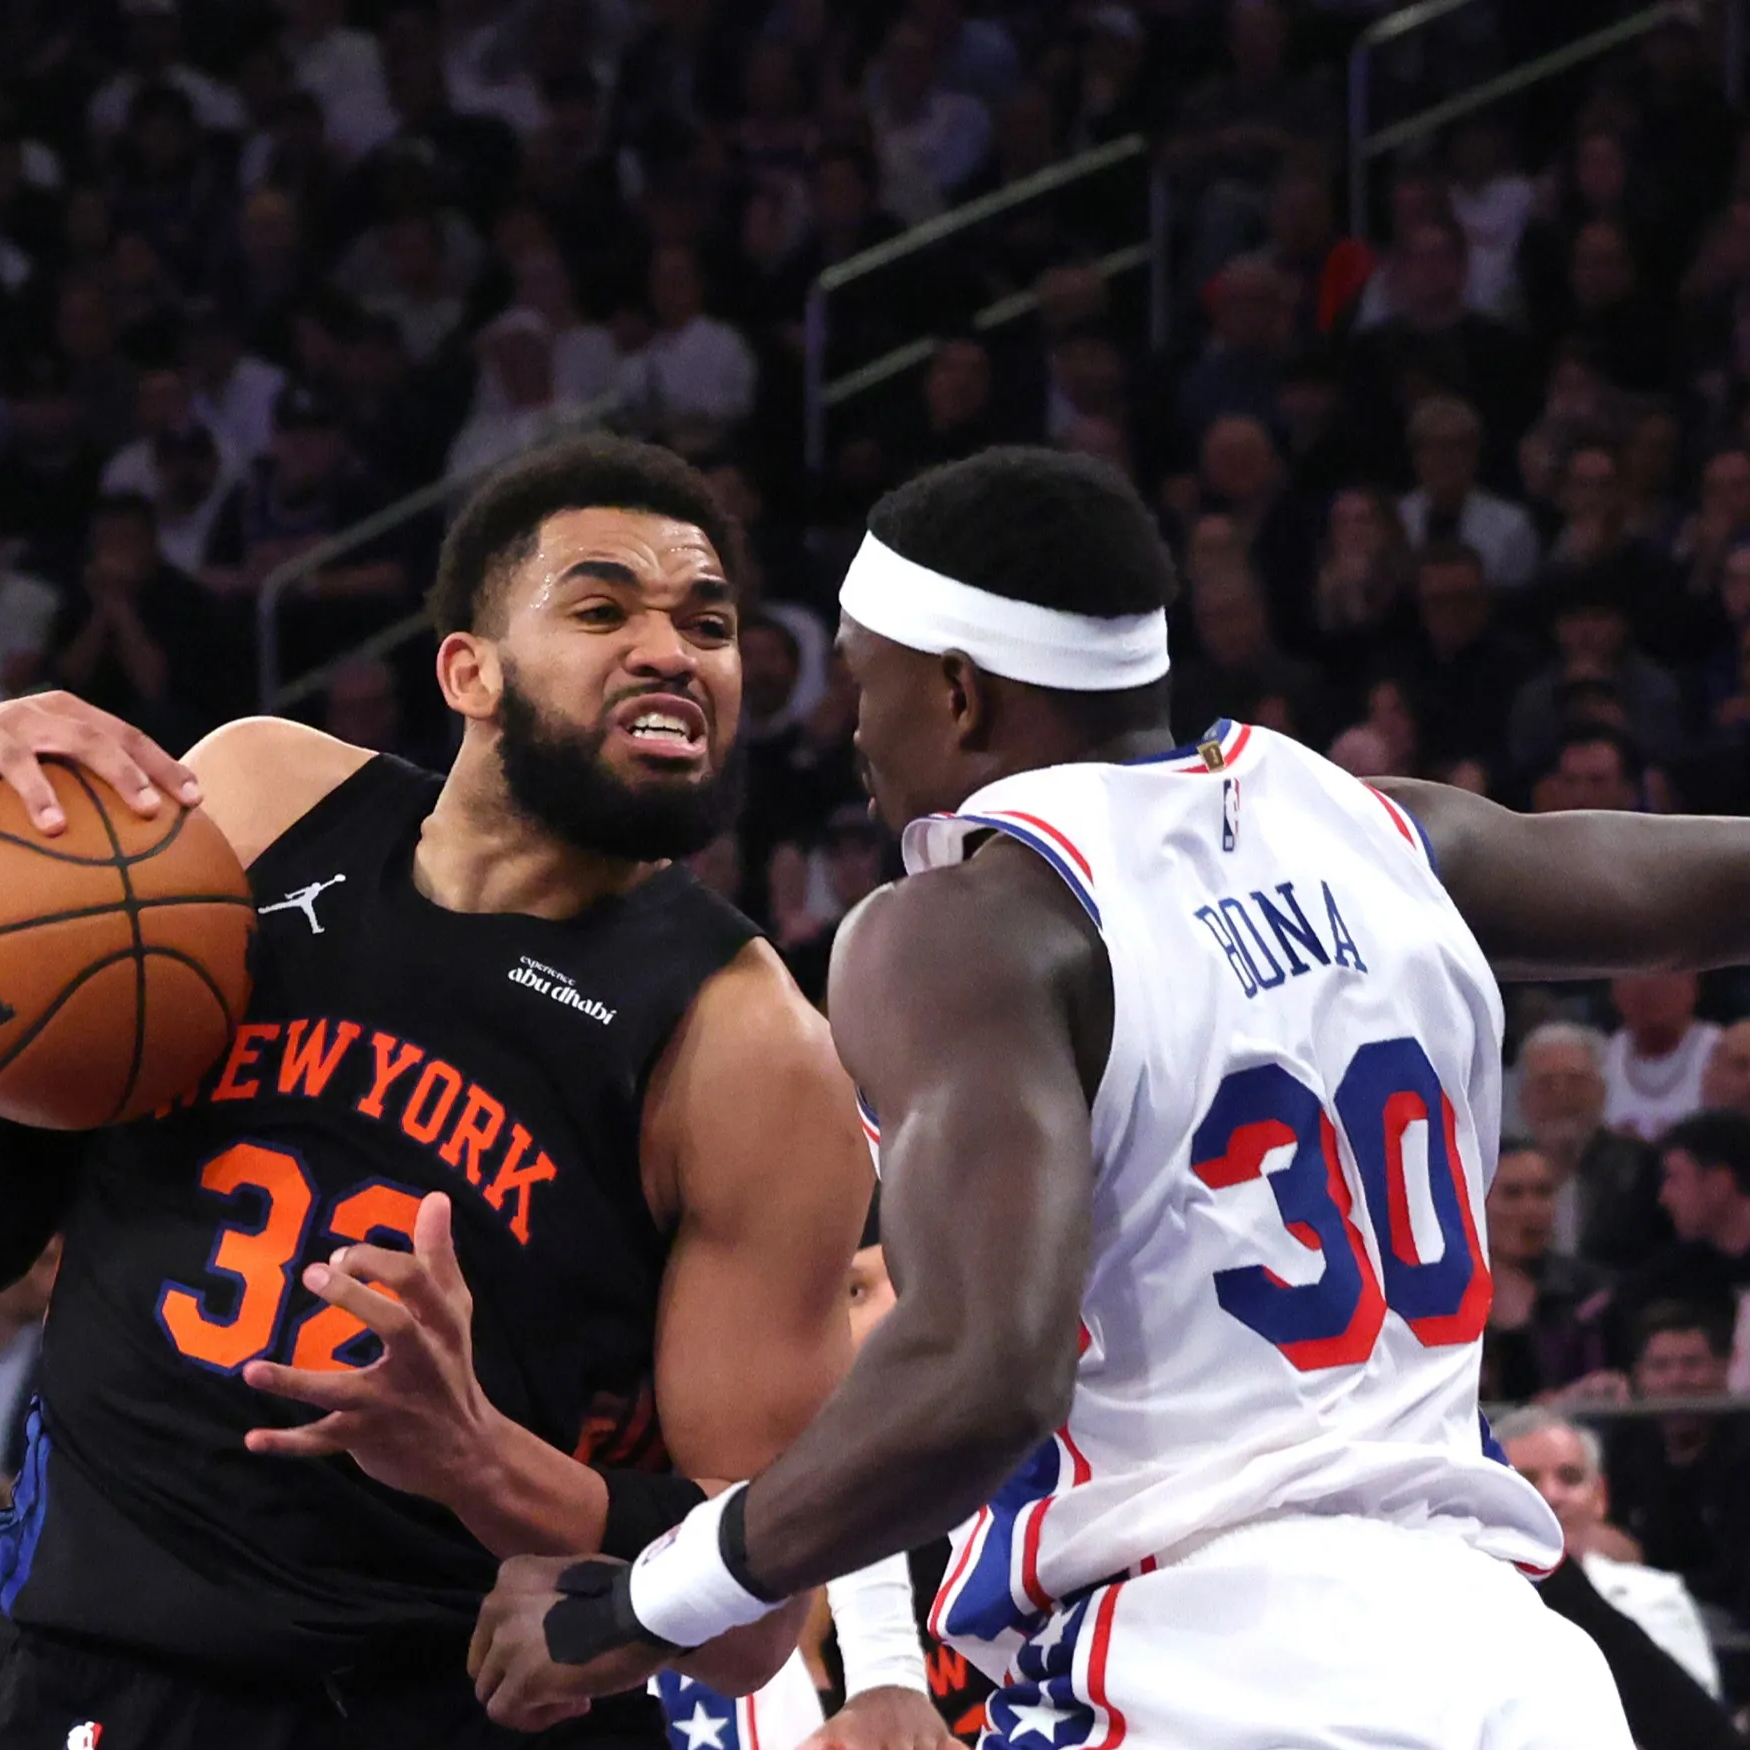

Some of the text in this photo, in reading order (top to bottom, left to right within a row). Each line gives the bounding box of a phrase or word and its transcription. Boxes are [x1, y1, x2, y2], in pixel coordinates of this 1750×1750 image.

[508, 967, 618, 1025] abu dhabi
[519, 955, 577, 986] experience
[1194, 880, 1368, 999] BONA
[155, 1017, 558, 1246] EW YORK
[1191, 1036, 1494, 1373] 30
